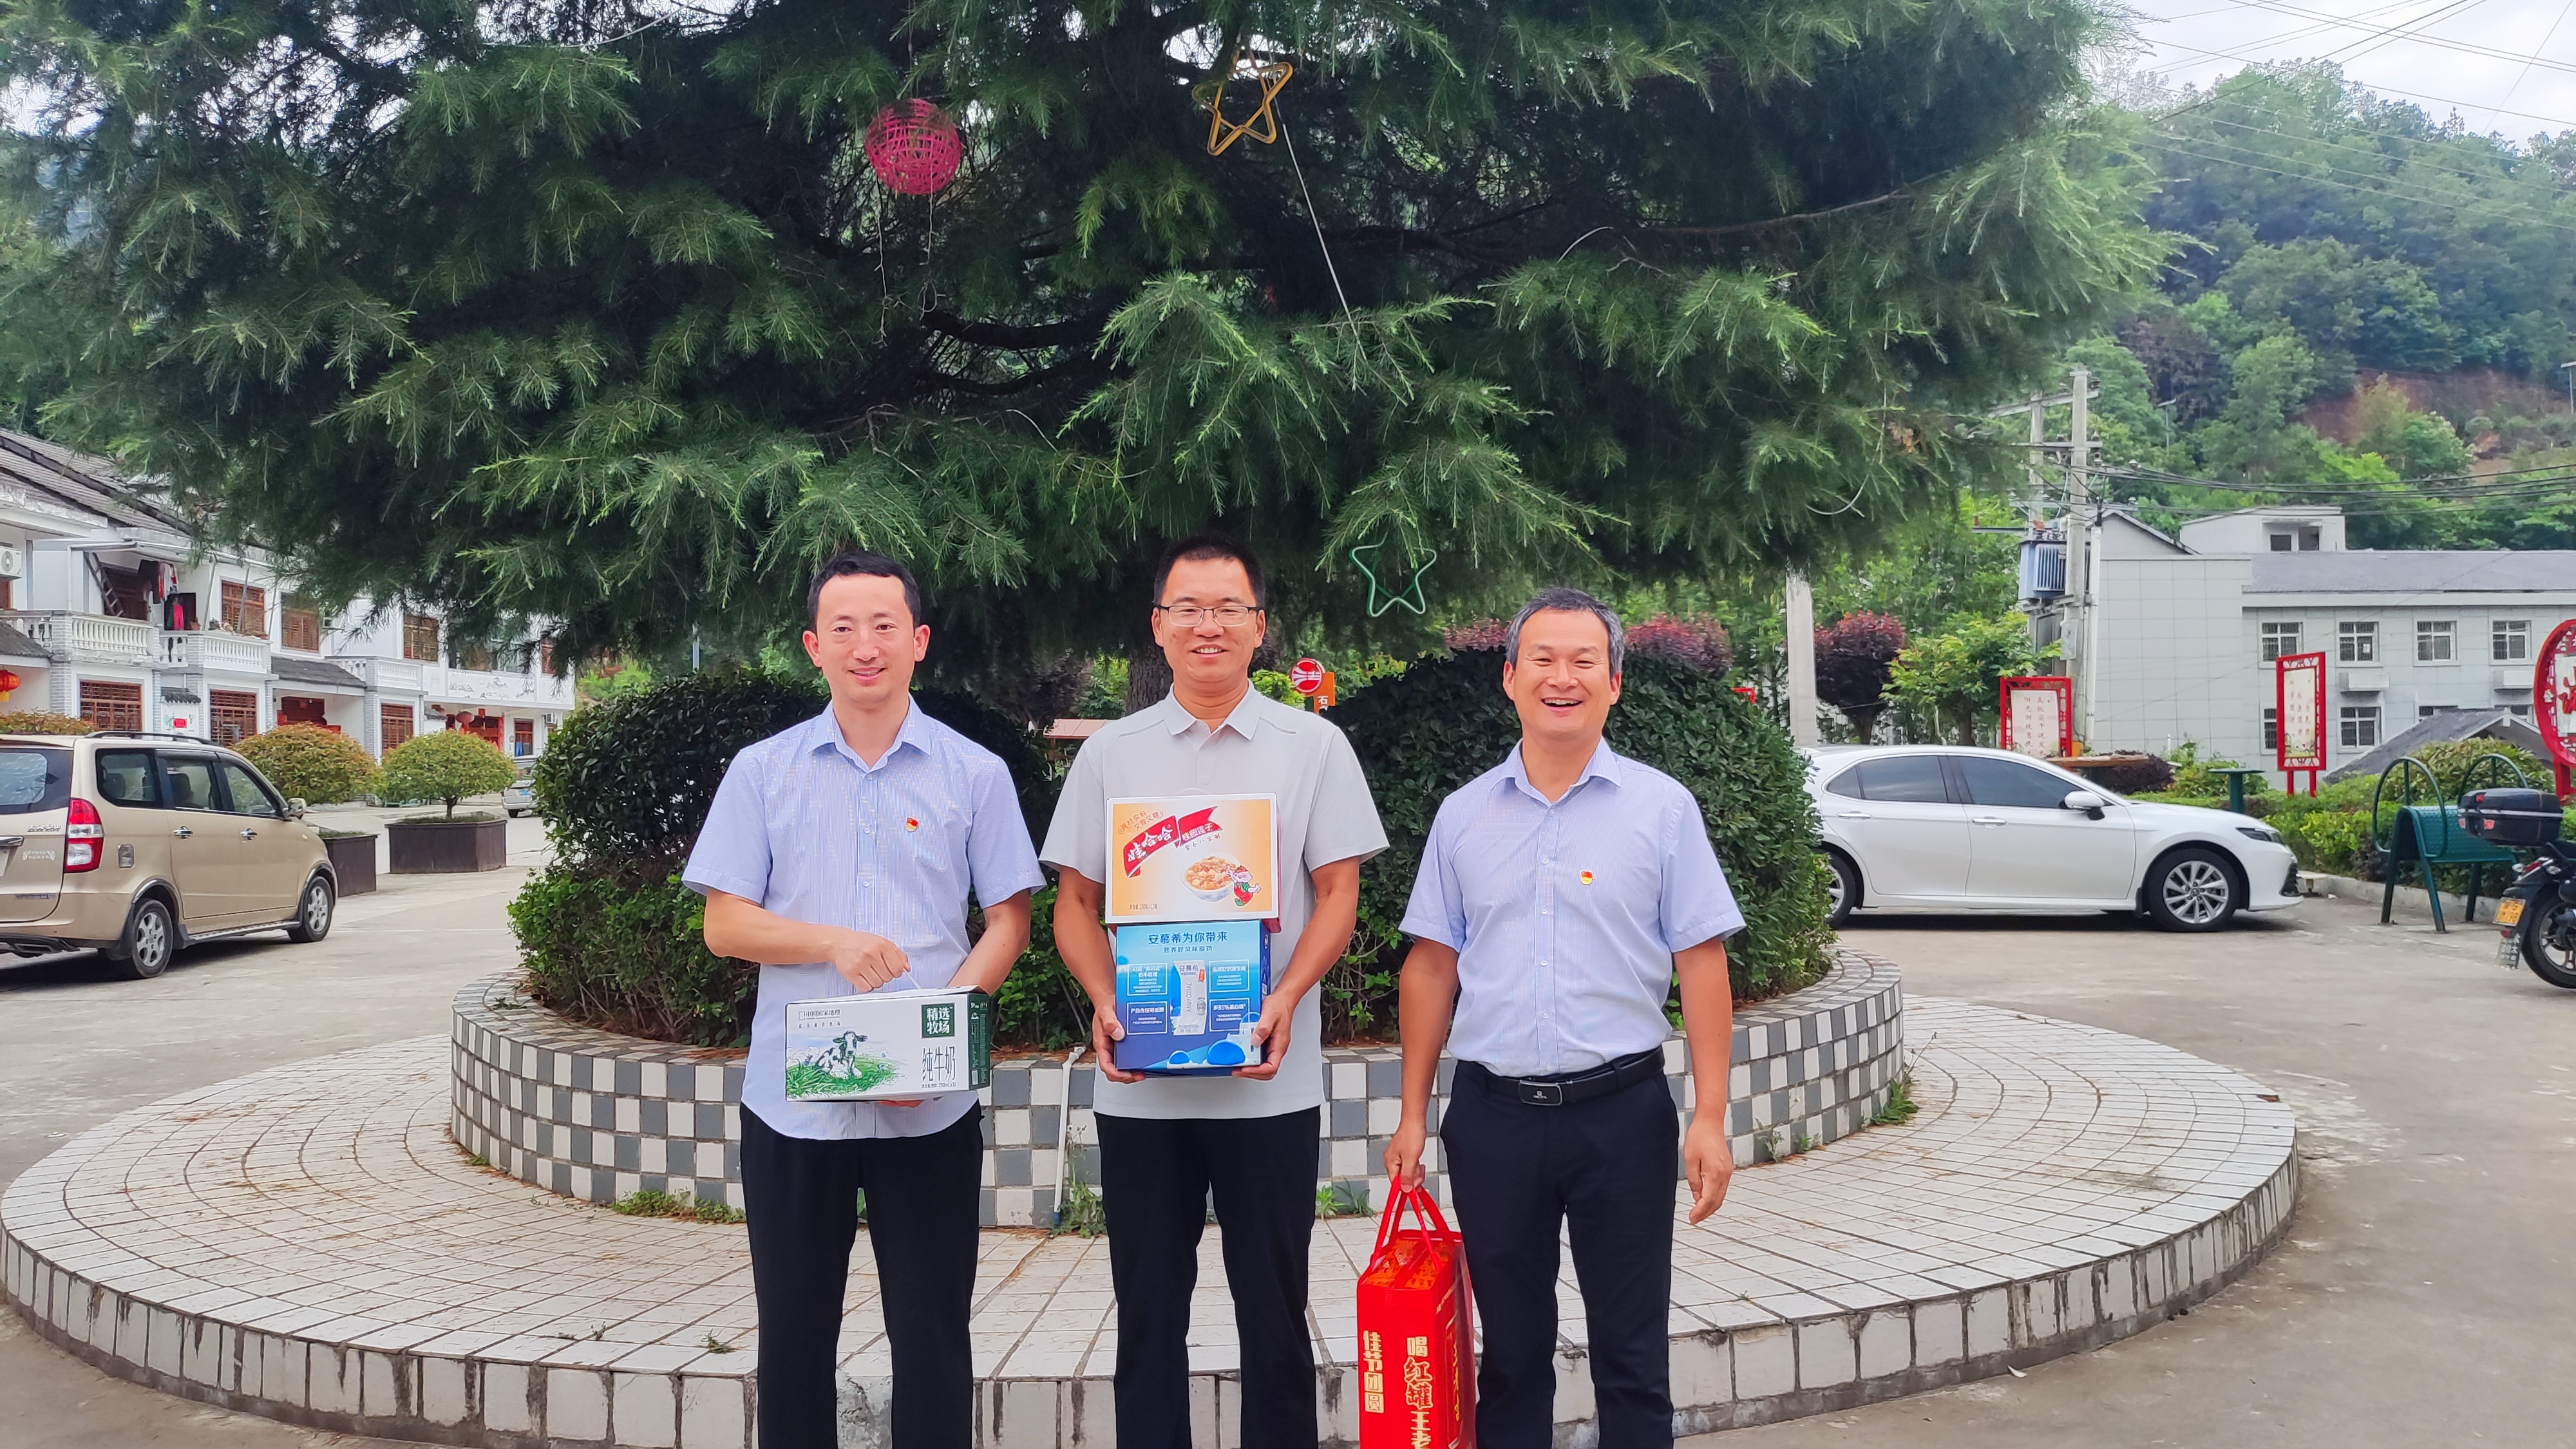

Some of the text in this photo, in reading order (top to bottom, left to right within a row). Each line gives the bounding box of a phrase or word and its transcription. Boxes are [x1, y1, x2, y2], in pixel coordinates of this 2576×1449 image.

[1148, 931, 1228, 945] 安慕希为你带来
[926, 1007, 951, 1021] 精选
[926, 1021, 951, 1035] 牧场
[922, 1045, 956, 1082] 纯牛奶
[1362, 1329, 1385, 1414] 佳节团圆
